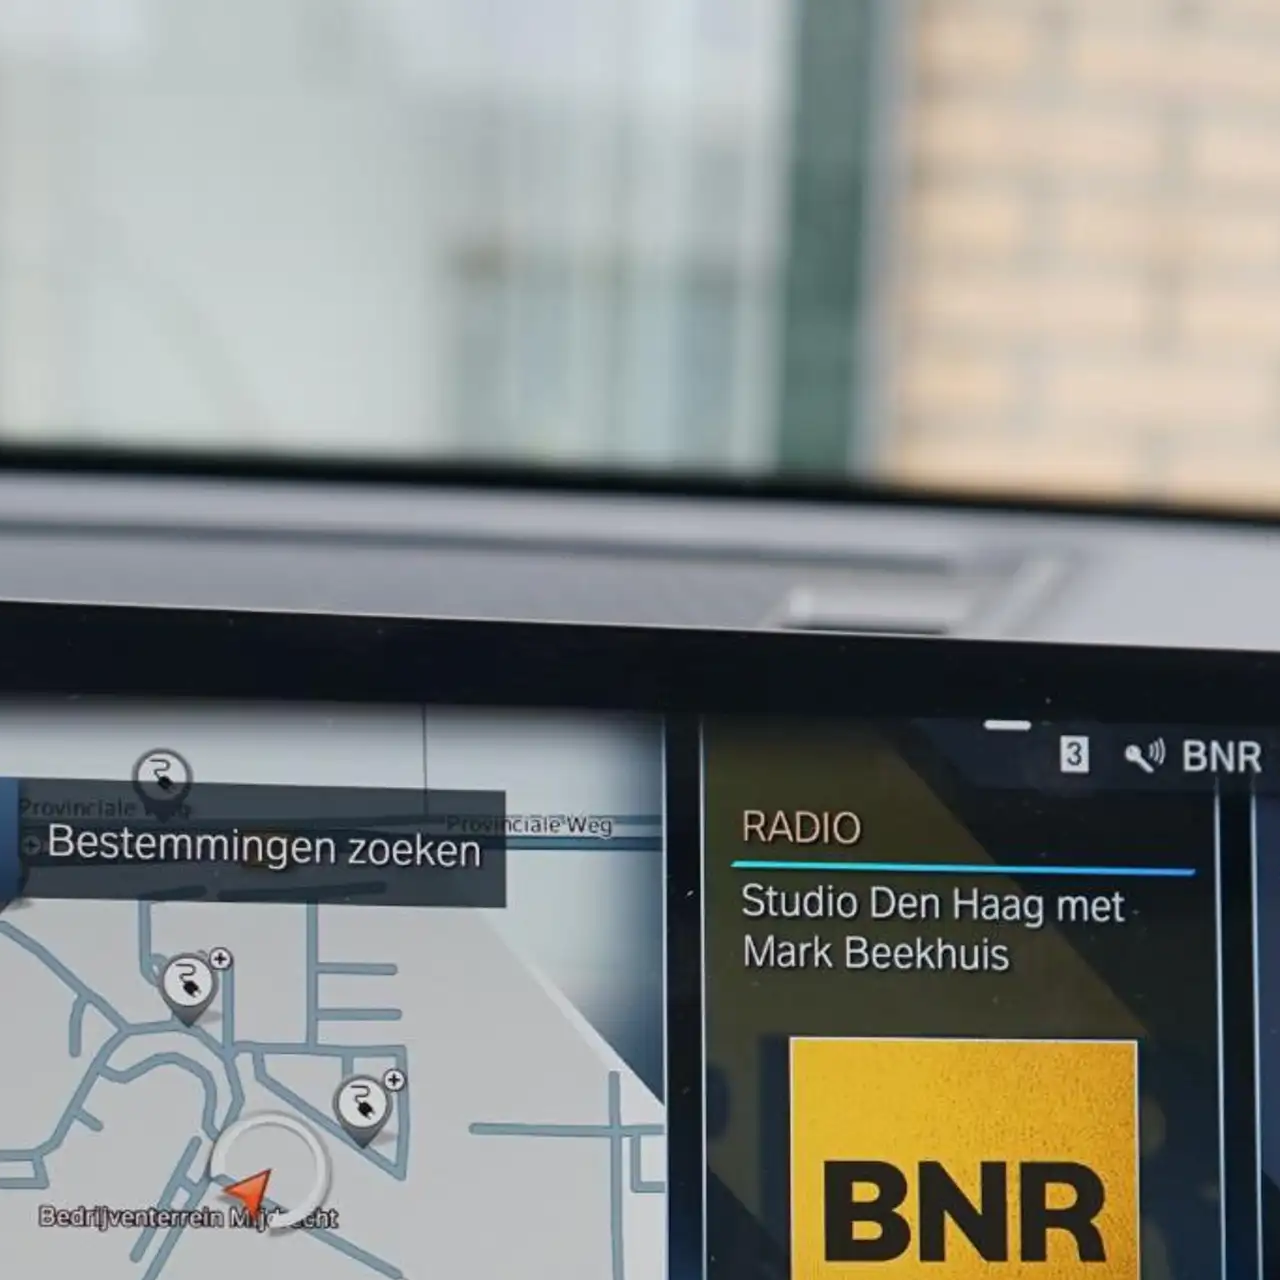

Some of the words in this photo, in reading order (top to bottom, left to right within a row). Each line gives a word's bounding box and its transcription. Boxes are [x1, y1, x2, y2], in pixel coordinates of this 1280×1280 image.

[1064, 738, 1086, 770] 3
[1183, 740, 1262, 774] BNR
[447, 815, 561, 834] Provinciale
[568, 816, 613, 838] Weg
[741, 809, 862, 845] RADIO
[48, 822, 337, 872] Bestemmingen
[348, 829, 482, 867] zoeken
[741, 884, 858, 922] Studio
[870, 886, 942, 922] Den
[953, 887, 1044, 928] Haag
[1056, 893, 1126, 924] met
[742, 934, 834, 970] Mark
[844, 935, 1010, 973] Beekhuis
[38, 1206, 224, 1231] Bedrijventerrein
[823, 1161, 1108, 1262] BNR
